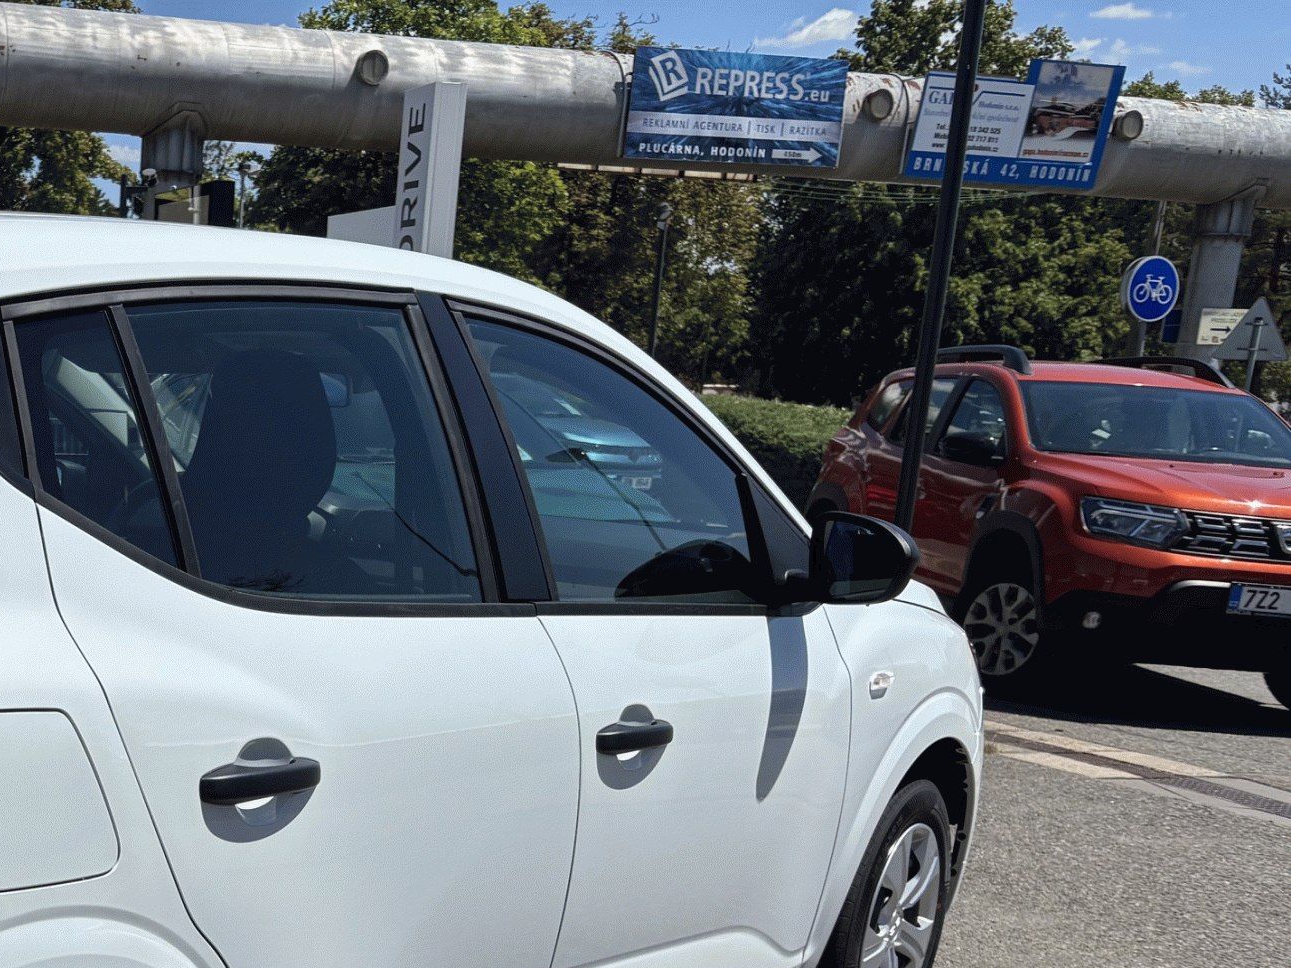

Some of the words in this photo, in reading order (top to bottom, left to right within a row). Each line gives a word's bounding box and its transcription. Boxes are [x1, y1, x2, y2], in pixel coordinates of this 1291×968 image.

[642, 117, 689, 129] REKLAMNÍ
[693, 120, 743, 133] AGENTURA
[756, 123, 776, 134] TISK
[639, 141, 705, 157] PLUCÁRNA,
[710, 145, 766, 158] HODONÍN
[913, 157, 991, 175] BRNSKÁ
[1030, 164, 1091, 182] HODONÍN
[1243, 589, 1280, 610] 7Z2
